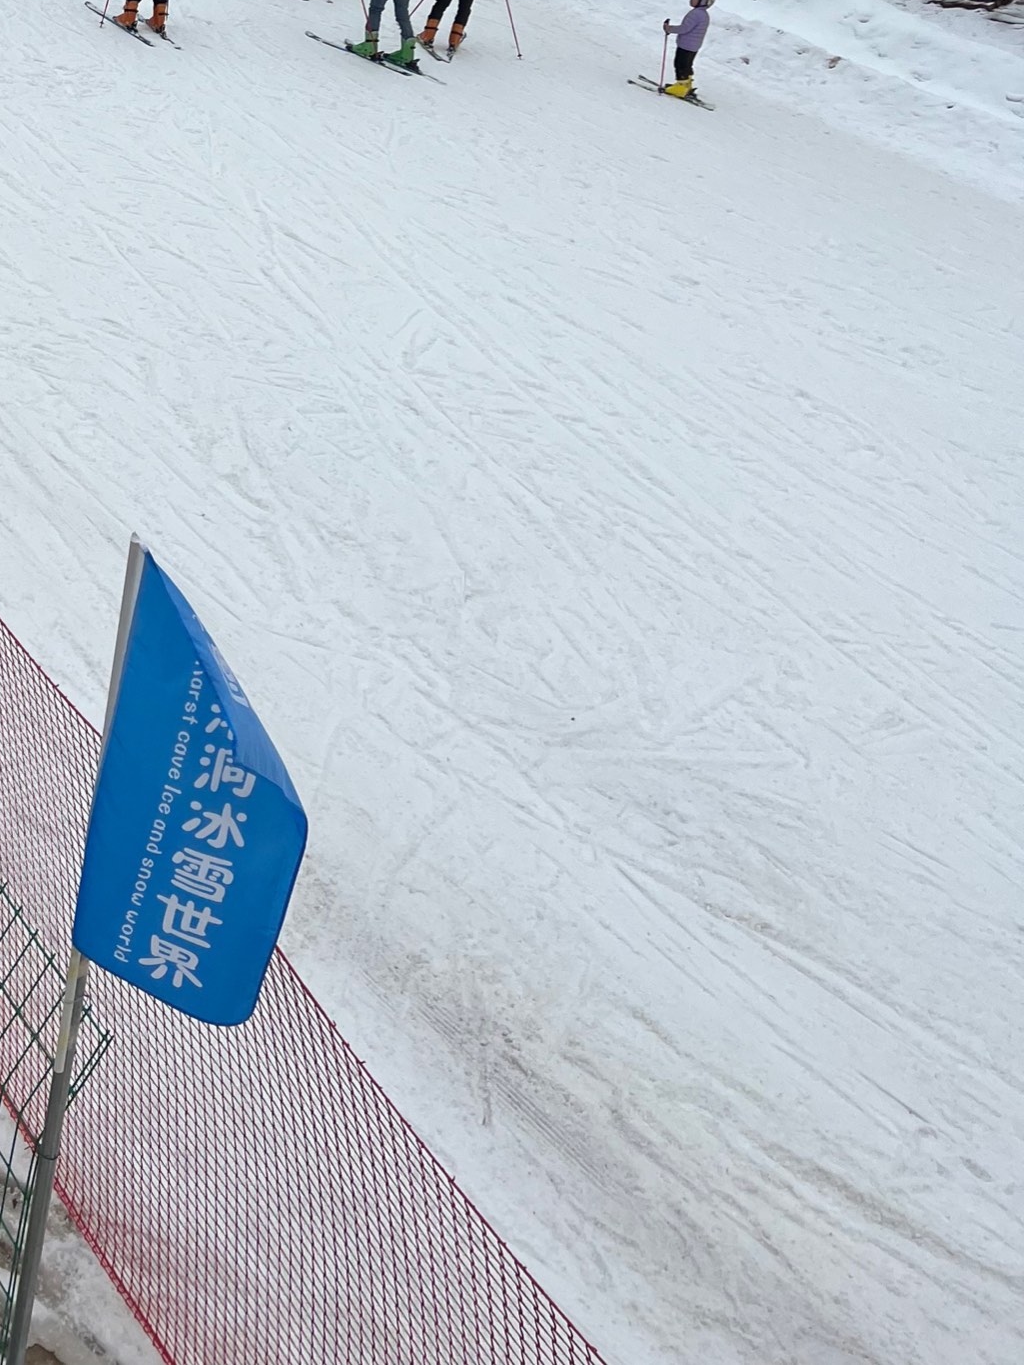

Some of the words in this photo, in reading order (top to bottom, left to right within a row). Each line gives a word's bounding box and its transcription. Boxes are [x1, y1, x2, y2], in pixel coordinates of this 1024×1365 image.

[167, 731, 191, 780] cave
[156, 782, 182, 815] Ice
[147, 817, 168, 854] and
[130, 857, 154, 907] snow
[113, 909, 141, 963] world
